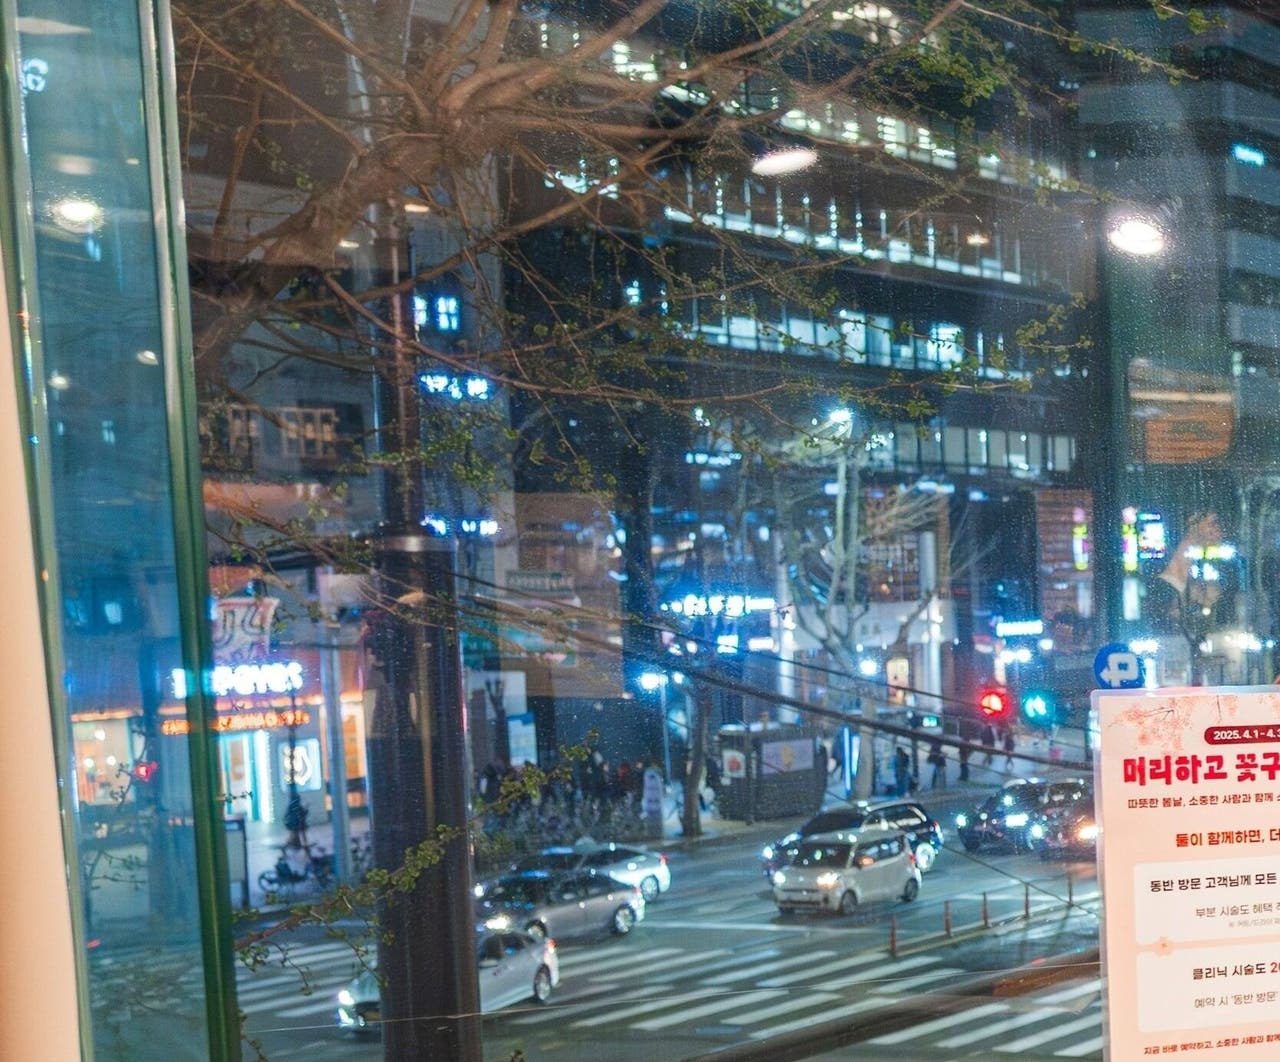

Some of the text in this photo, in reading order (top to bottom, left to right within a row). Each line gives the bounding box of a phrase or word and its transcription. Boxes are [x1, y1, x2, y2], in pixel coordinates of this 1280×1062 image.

[1123, 754, 1228, 786] 머리하고
[1128, 798, 1159, 809] 따뜻한
[1162, 797, 1186, 808] 봄날,
[1188, 795, 1219, 806] 소중한
[1222, 794, 1251, 804] 사람과
[1255, 792, 1274, 803] 함께
[1175, 833, 1203, 847] 둘이
[1207, 829, 1265, 846] 함께하면,
[1150, 880, 1174, 893] 동반
[1178, 877, 1201, 890] 방문
[1205, 874, 1252, 889] 고객님께
[1255, 872, 1277, 885] 모든
[1195, 907, 1217, 918] 부분
[1219, 904, 1250, 916] 시술도
[1252, 903, 1273, 914] 혜택
[1193, 966, 1228, 980] 클리닉
[1232, 963, 1266, 976] 시술도
[1194, 997, 1216, 1009] 예약
[1218, 996, 1229, 1007] 시
[1144, 1046, 1160, 1055] 지금
